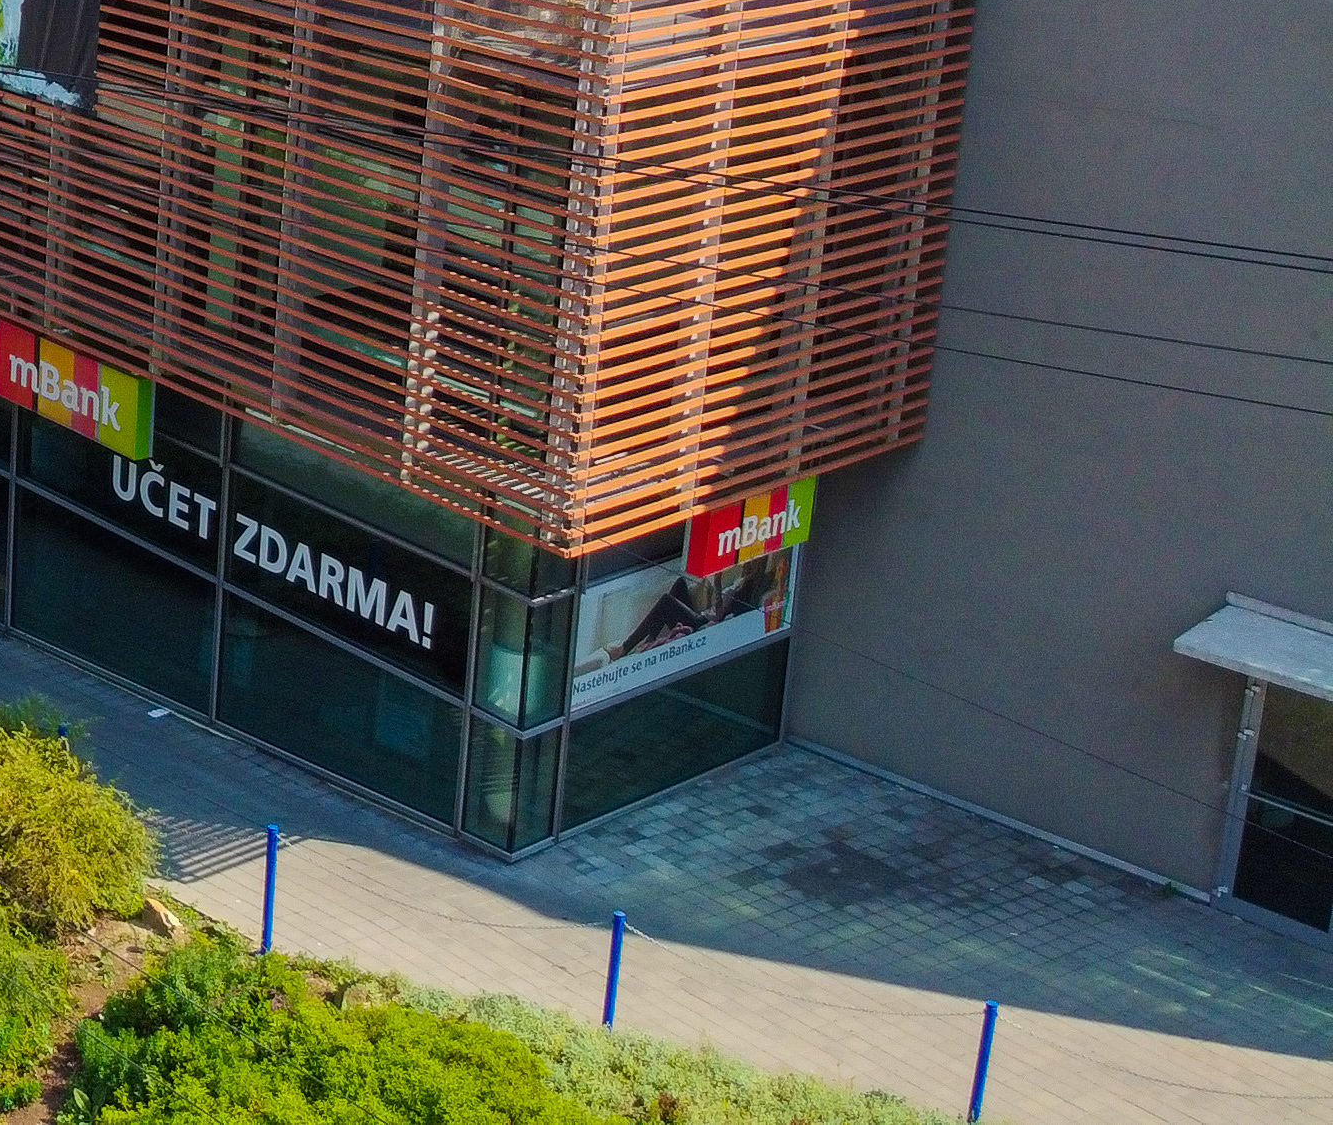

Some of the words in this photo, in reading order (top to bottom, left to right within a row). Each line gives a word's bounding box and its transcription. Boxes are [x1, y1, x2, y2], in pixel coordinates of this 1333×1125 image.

[8, 348, 122, 432] mBank
[112, 452, 216, 542] UČET
[233, 512, 436, 650] ZDARMA!
[717, 499, 801, 557] mBank
[573, 665, 629, 696] Nastěhujte
[631, 661, 642, 674] se
[644, 656, 657, 667] na
[659, 635, 707, 663] mBank.cz
